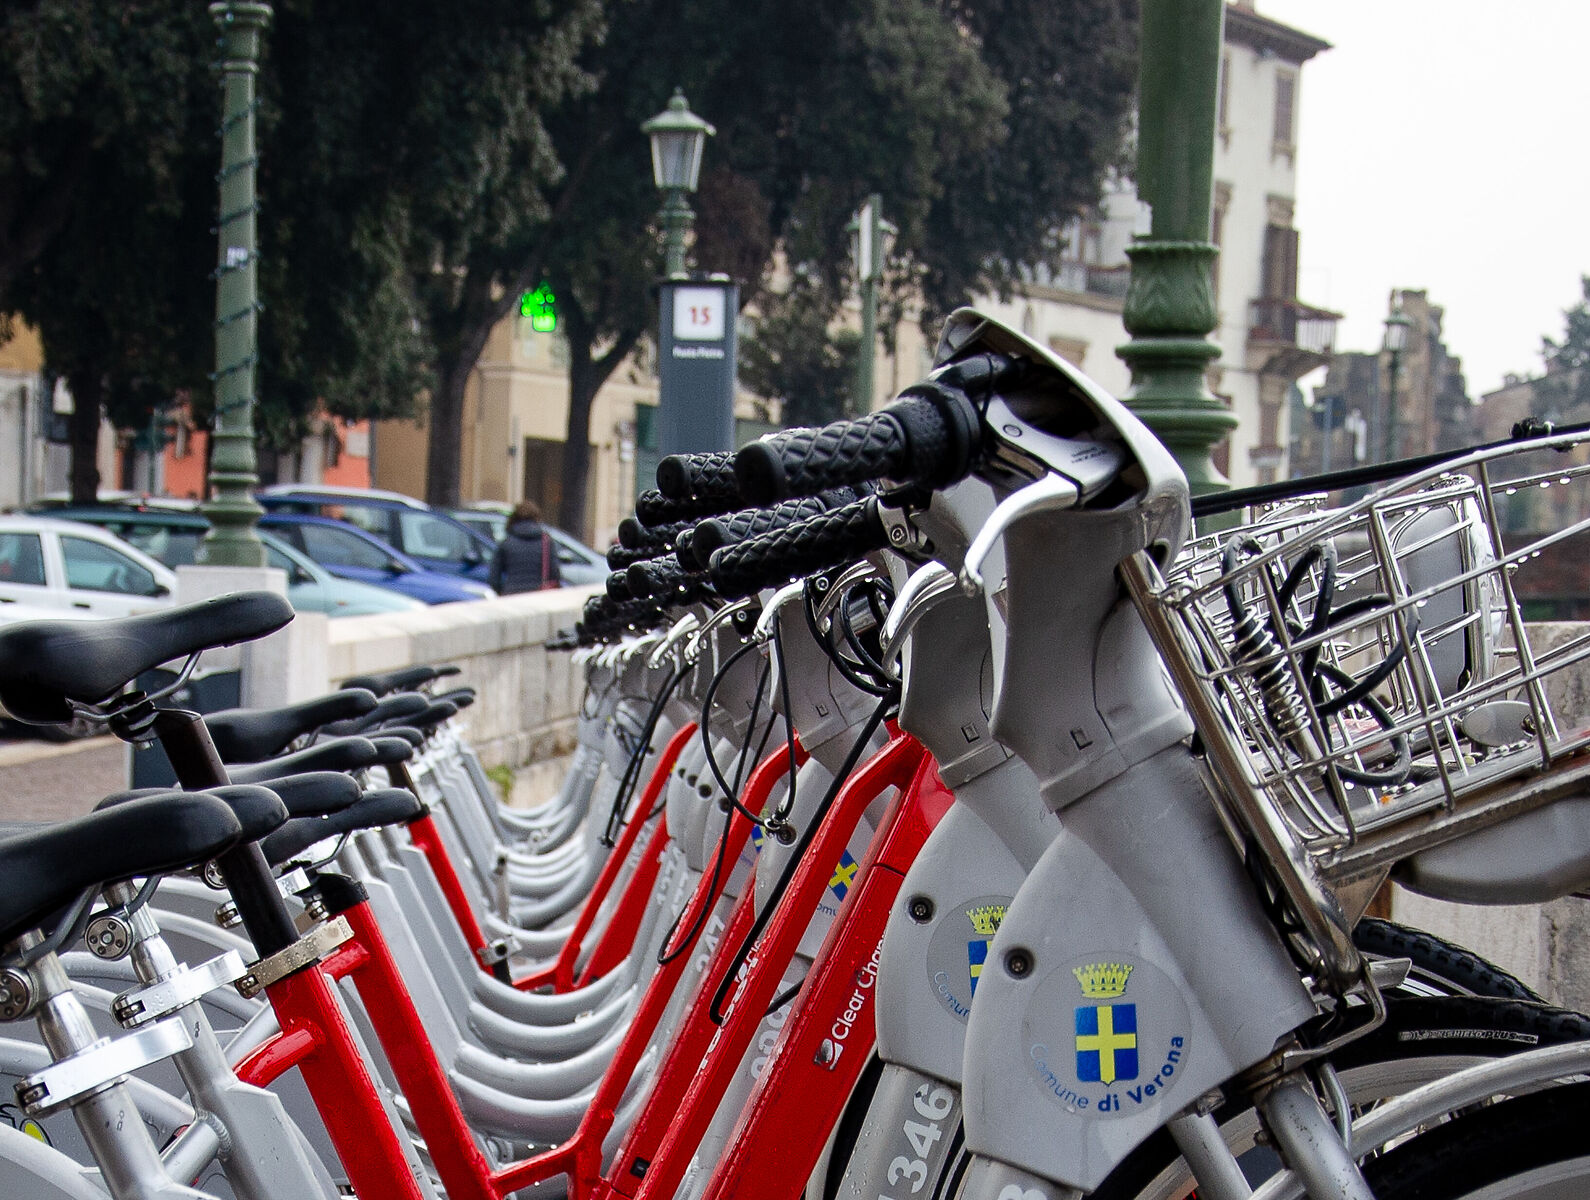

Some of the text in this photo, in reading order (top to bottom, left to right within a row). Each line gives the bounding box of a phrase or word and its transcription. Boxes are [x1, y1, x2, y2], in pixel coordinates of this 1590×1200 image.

[690, 305, 711, 326] 15
[831, 989, 865, 1040] Clear
[1030, 1036, 1184, 1112] Comune di Verona
